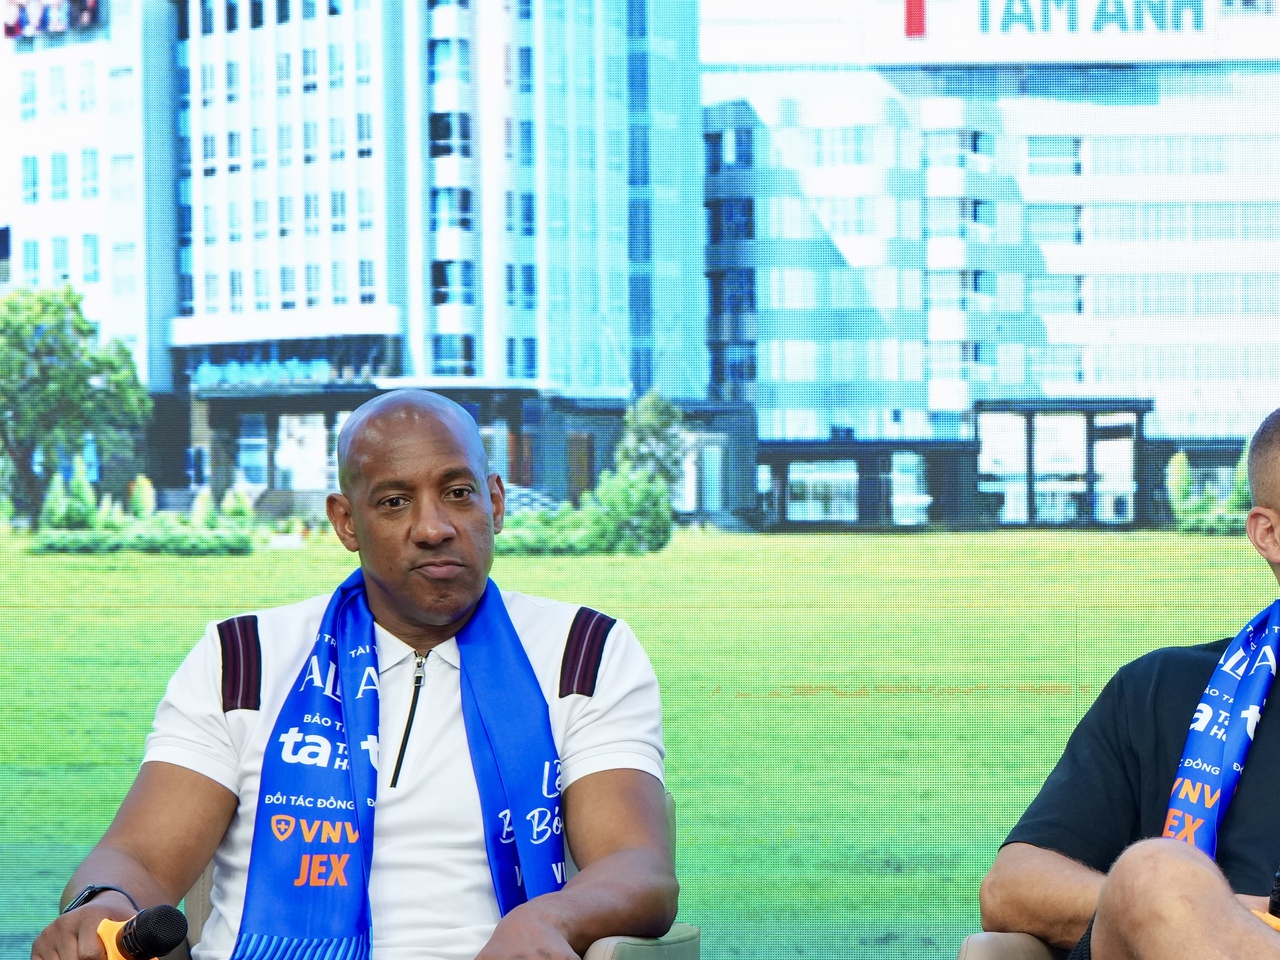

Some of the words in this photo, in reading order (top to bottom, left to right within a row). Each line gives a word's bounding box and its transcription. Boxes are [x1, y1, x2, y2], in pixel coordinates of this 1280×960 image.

[349, 645, 370, 658] TÀI
[303, 712, 332, 727] BẢO
[278, 726, 332, 768] ta
[1183, 757, 1221, 775] ĐỒNG
[264, 791, 287, 804] ĐỐI
[289, 794, 315, 807] TÁC
[299, 818, 360, 843] VNV
[1161, 808, 1205, 846] EX
[293, 853, 351, 887] JEX
